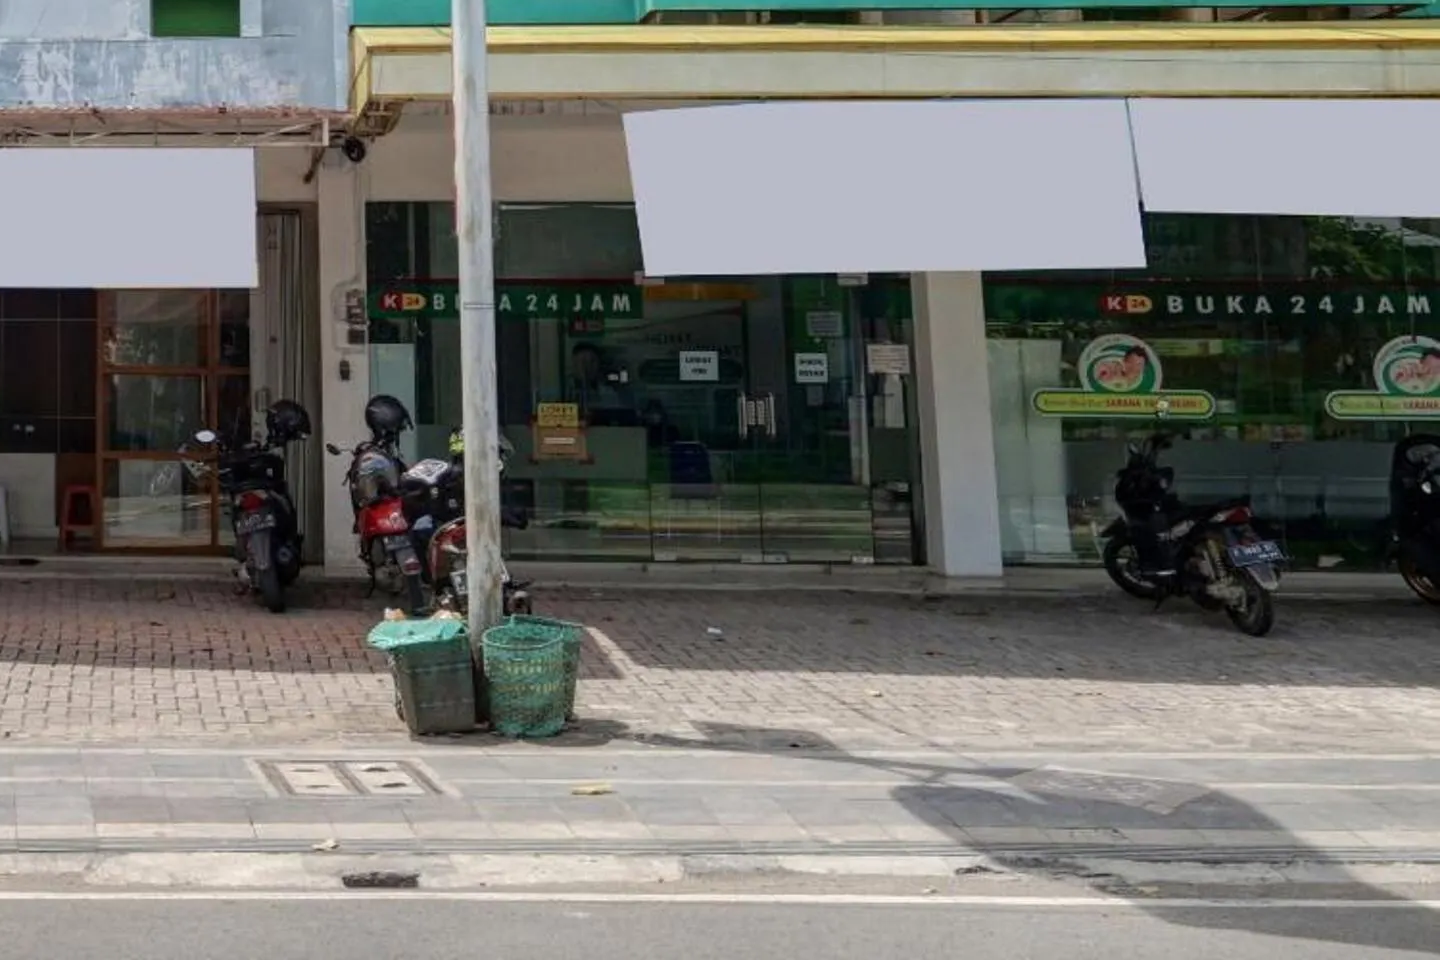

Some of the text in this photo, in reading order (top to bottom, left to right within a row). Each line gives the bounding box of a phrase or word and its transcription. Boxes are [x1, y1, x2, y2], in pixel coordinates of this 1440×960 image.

[432, 293, 512, 310] BA
[526, 293, 558, 311] 24
[572, 293, 631, 311] JAM
[1167, 295, 1273, 314] BUKA
[1290, 295, 1334, 313] 24
[1352, 295, 1431, 314] JAM
